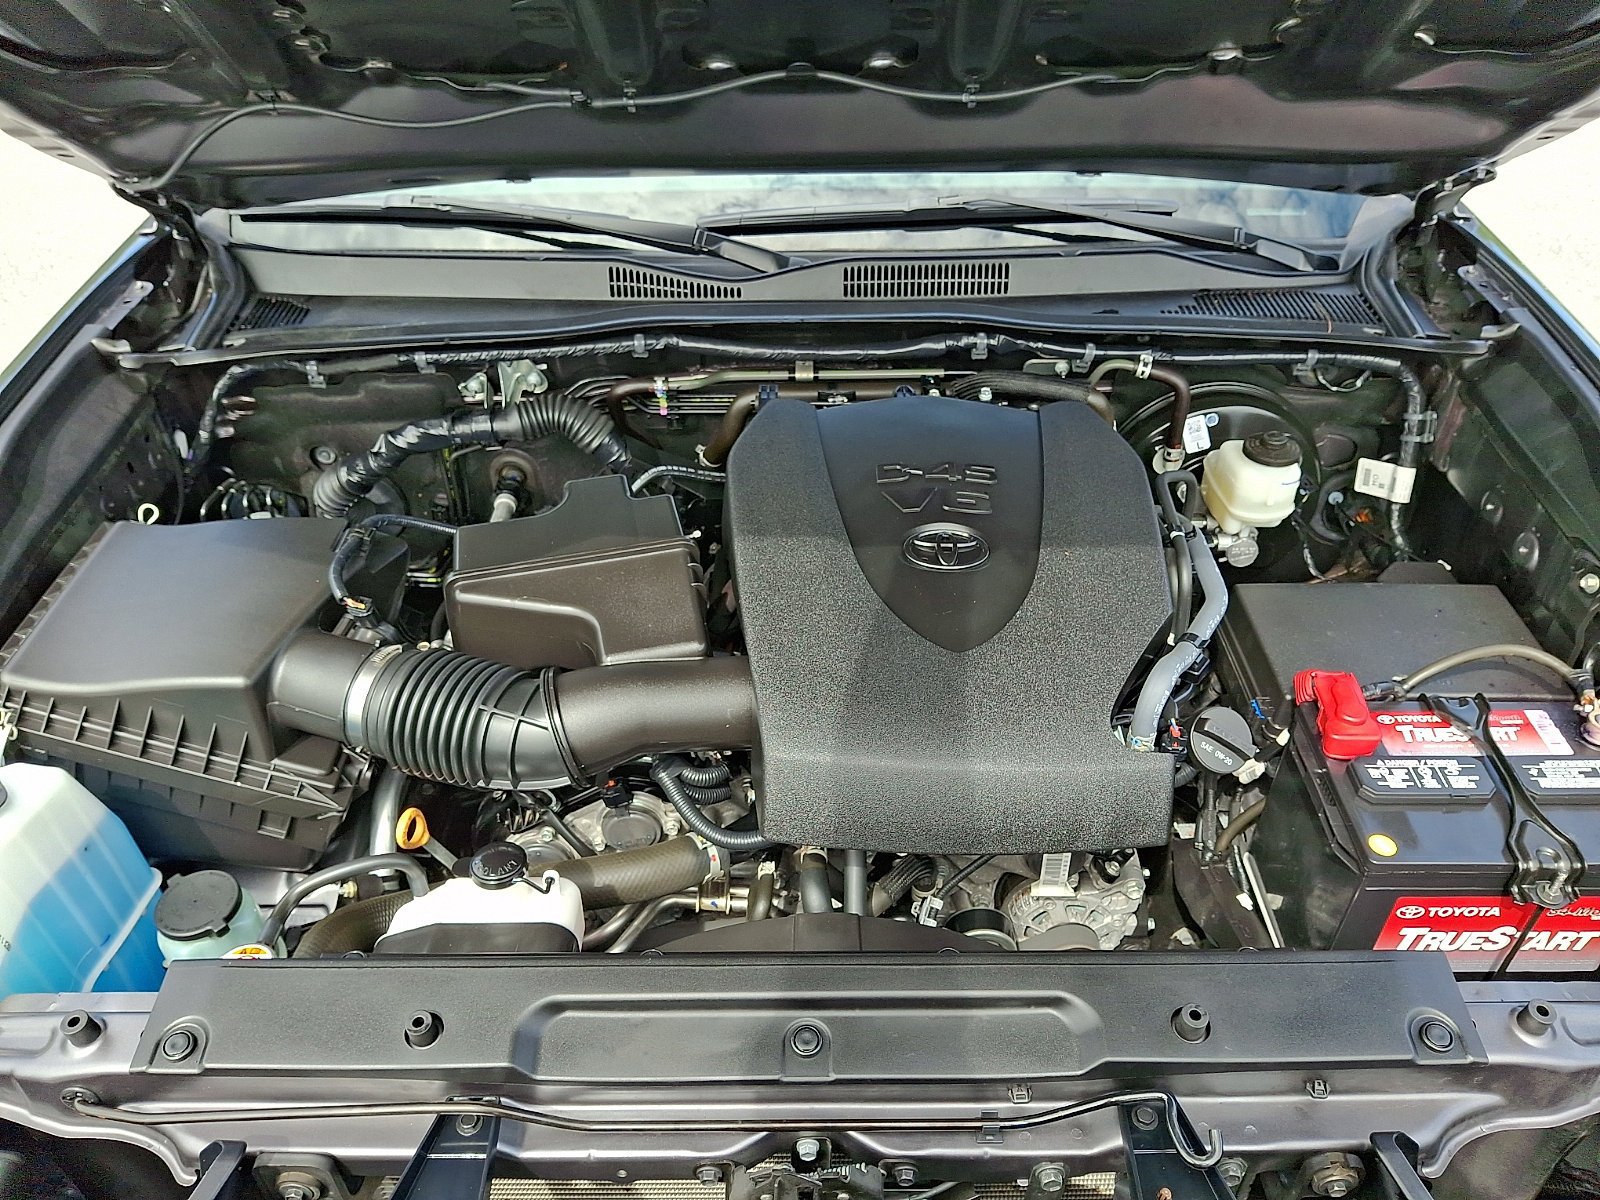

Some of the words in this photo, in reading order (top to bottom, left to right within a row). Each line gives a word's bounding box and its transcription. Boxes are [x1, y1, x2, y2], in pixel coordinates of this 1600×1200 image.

[875, 463, 998, 484] D-4S
[1394, 714, 1442, 723] TOYOTA
[1395, 724, 1520, 743] TRUESRT
[1200, 741, 1214, 753] SAE
[1214, 750, 1233, 766] 0W-20
[474, 859, 518, 876] OLANT
[1428, 906, 1501, 918] TOYOTA
